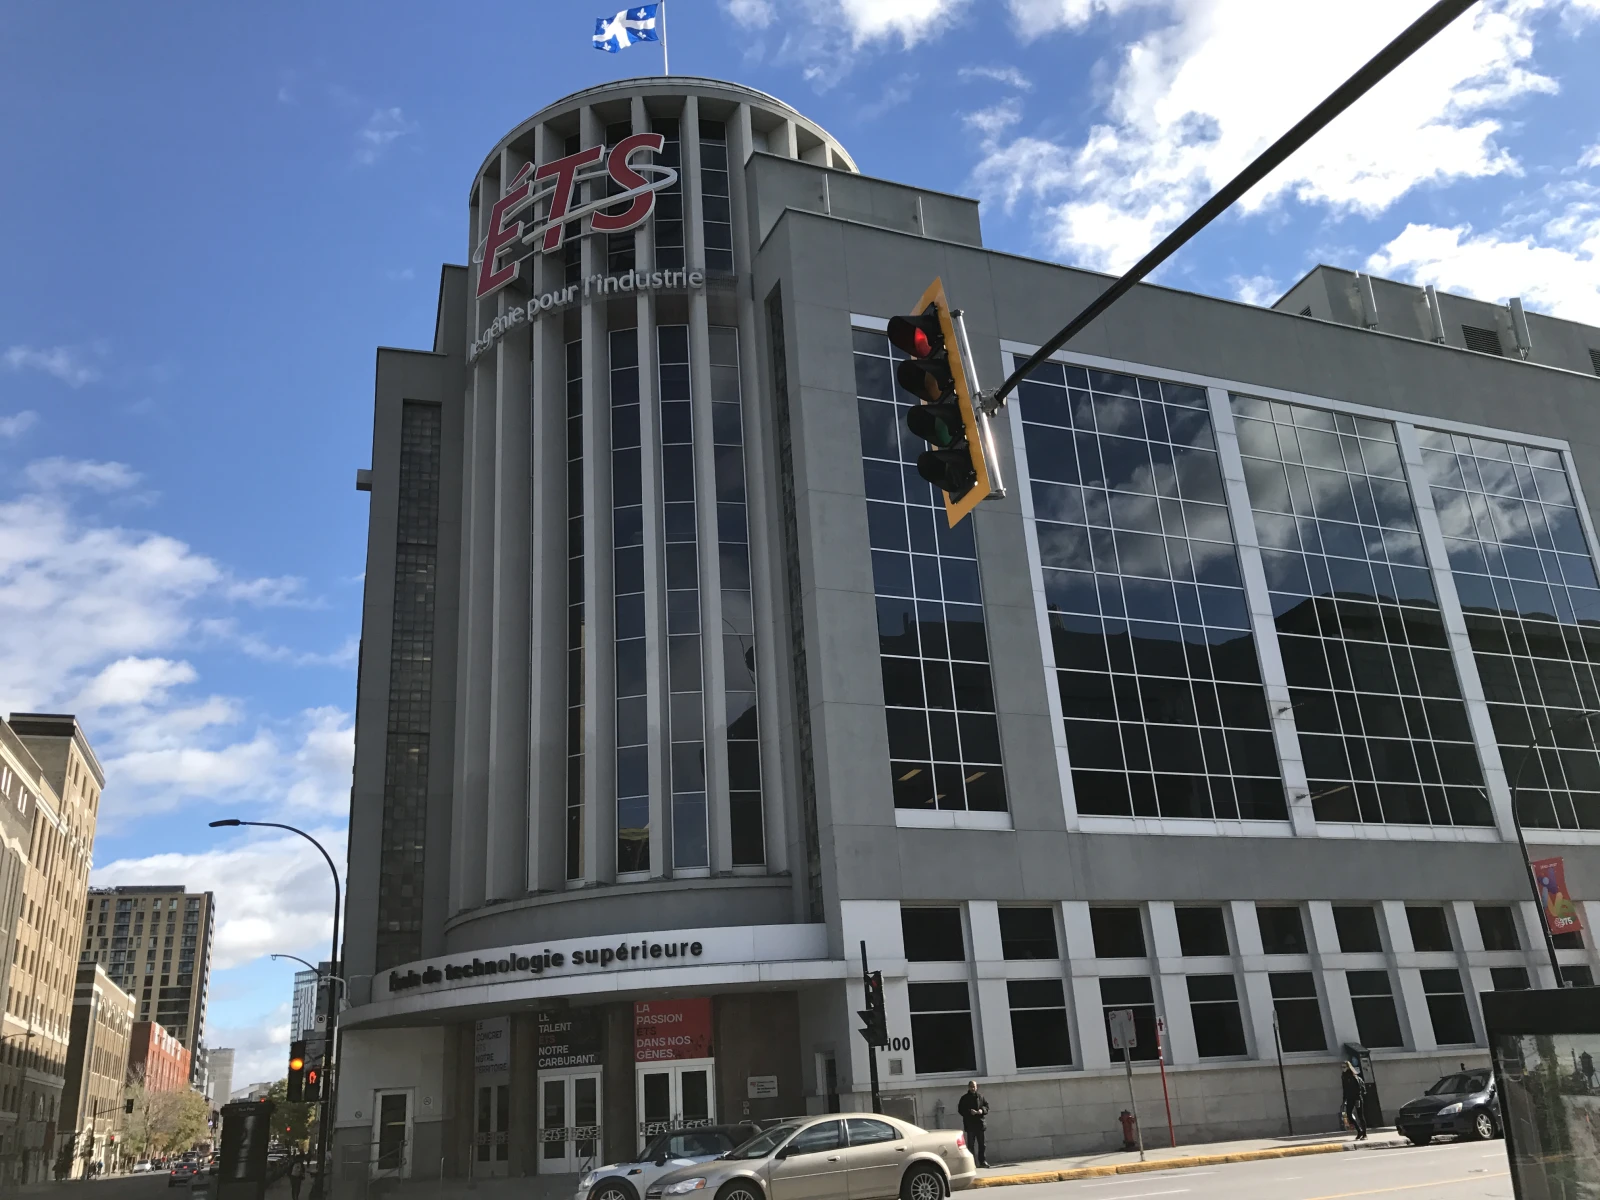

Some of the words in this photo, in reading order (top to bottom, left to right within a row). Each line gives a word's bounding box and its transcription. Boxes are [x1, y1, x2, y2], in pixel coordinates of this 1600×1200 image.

[476, 132, 665, 299] ÉTS
[527, 285, 579, 322] pour
[584, 266, 704, 298] l'industrie
[422, 966, 442, 984] de
[445, 949, 565, 981] technologie
[571, 940, 703, 968] supérieure
[636, 1004, 650, 1013] LA
[538, 1013, 550, 1022] LE
[636, 1013, 683, 1025] PASSION
[538, 1022, 572, 1034] TALENT
[636, 1026, 657, 1037] ETS
[476, 1030, 503, 1042] CONCRET
[636, 1037, 666, 1048] DANS
[667, 1036, 691, 1045] NOS
[538, 1045, 569, 1056] NOTRE
[475, 1053, 495, 1063] NOTRE
[538, 1054, 596, 1068] CARBURANT.
